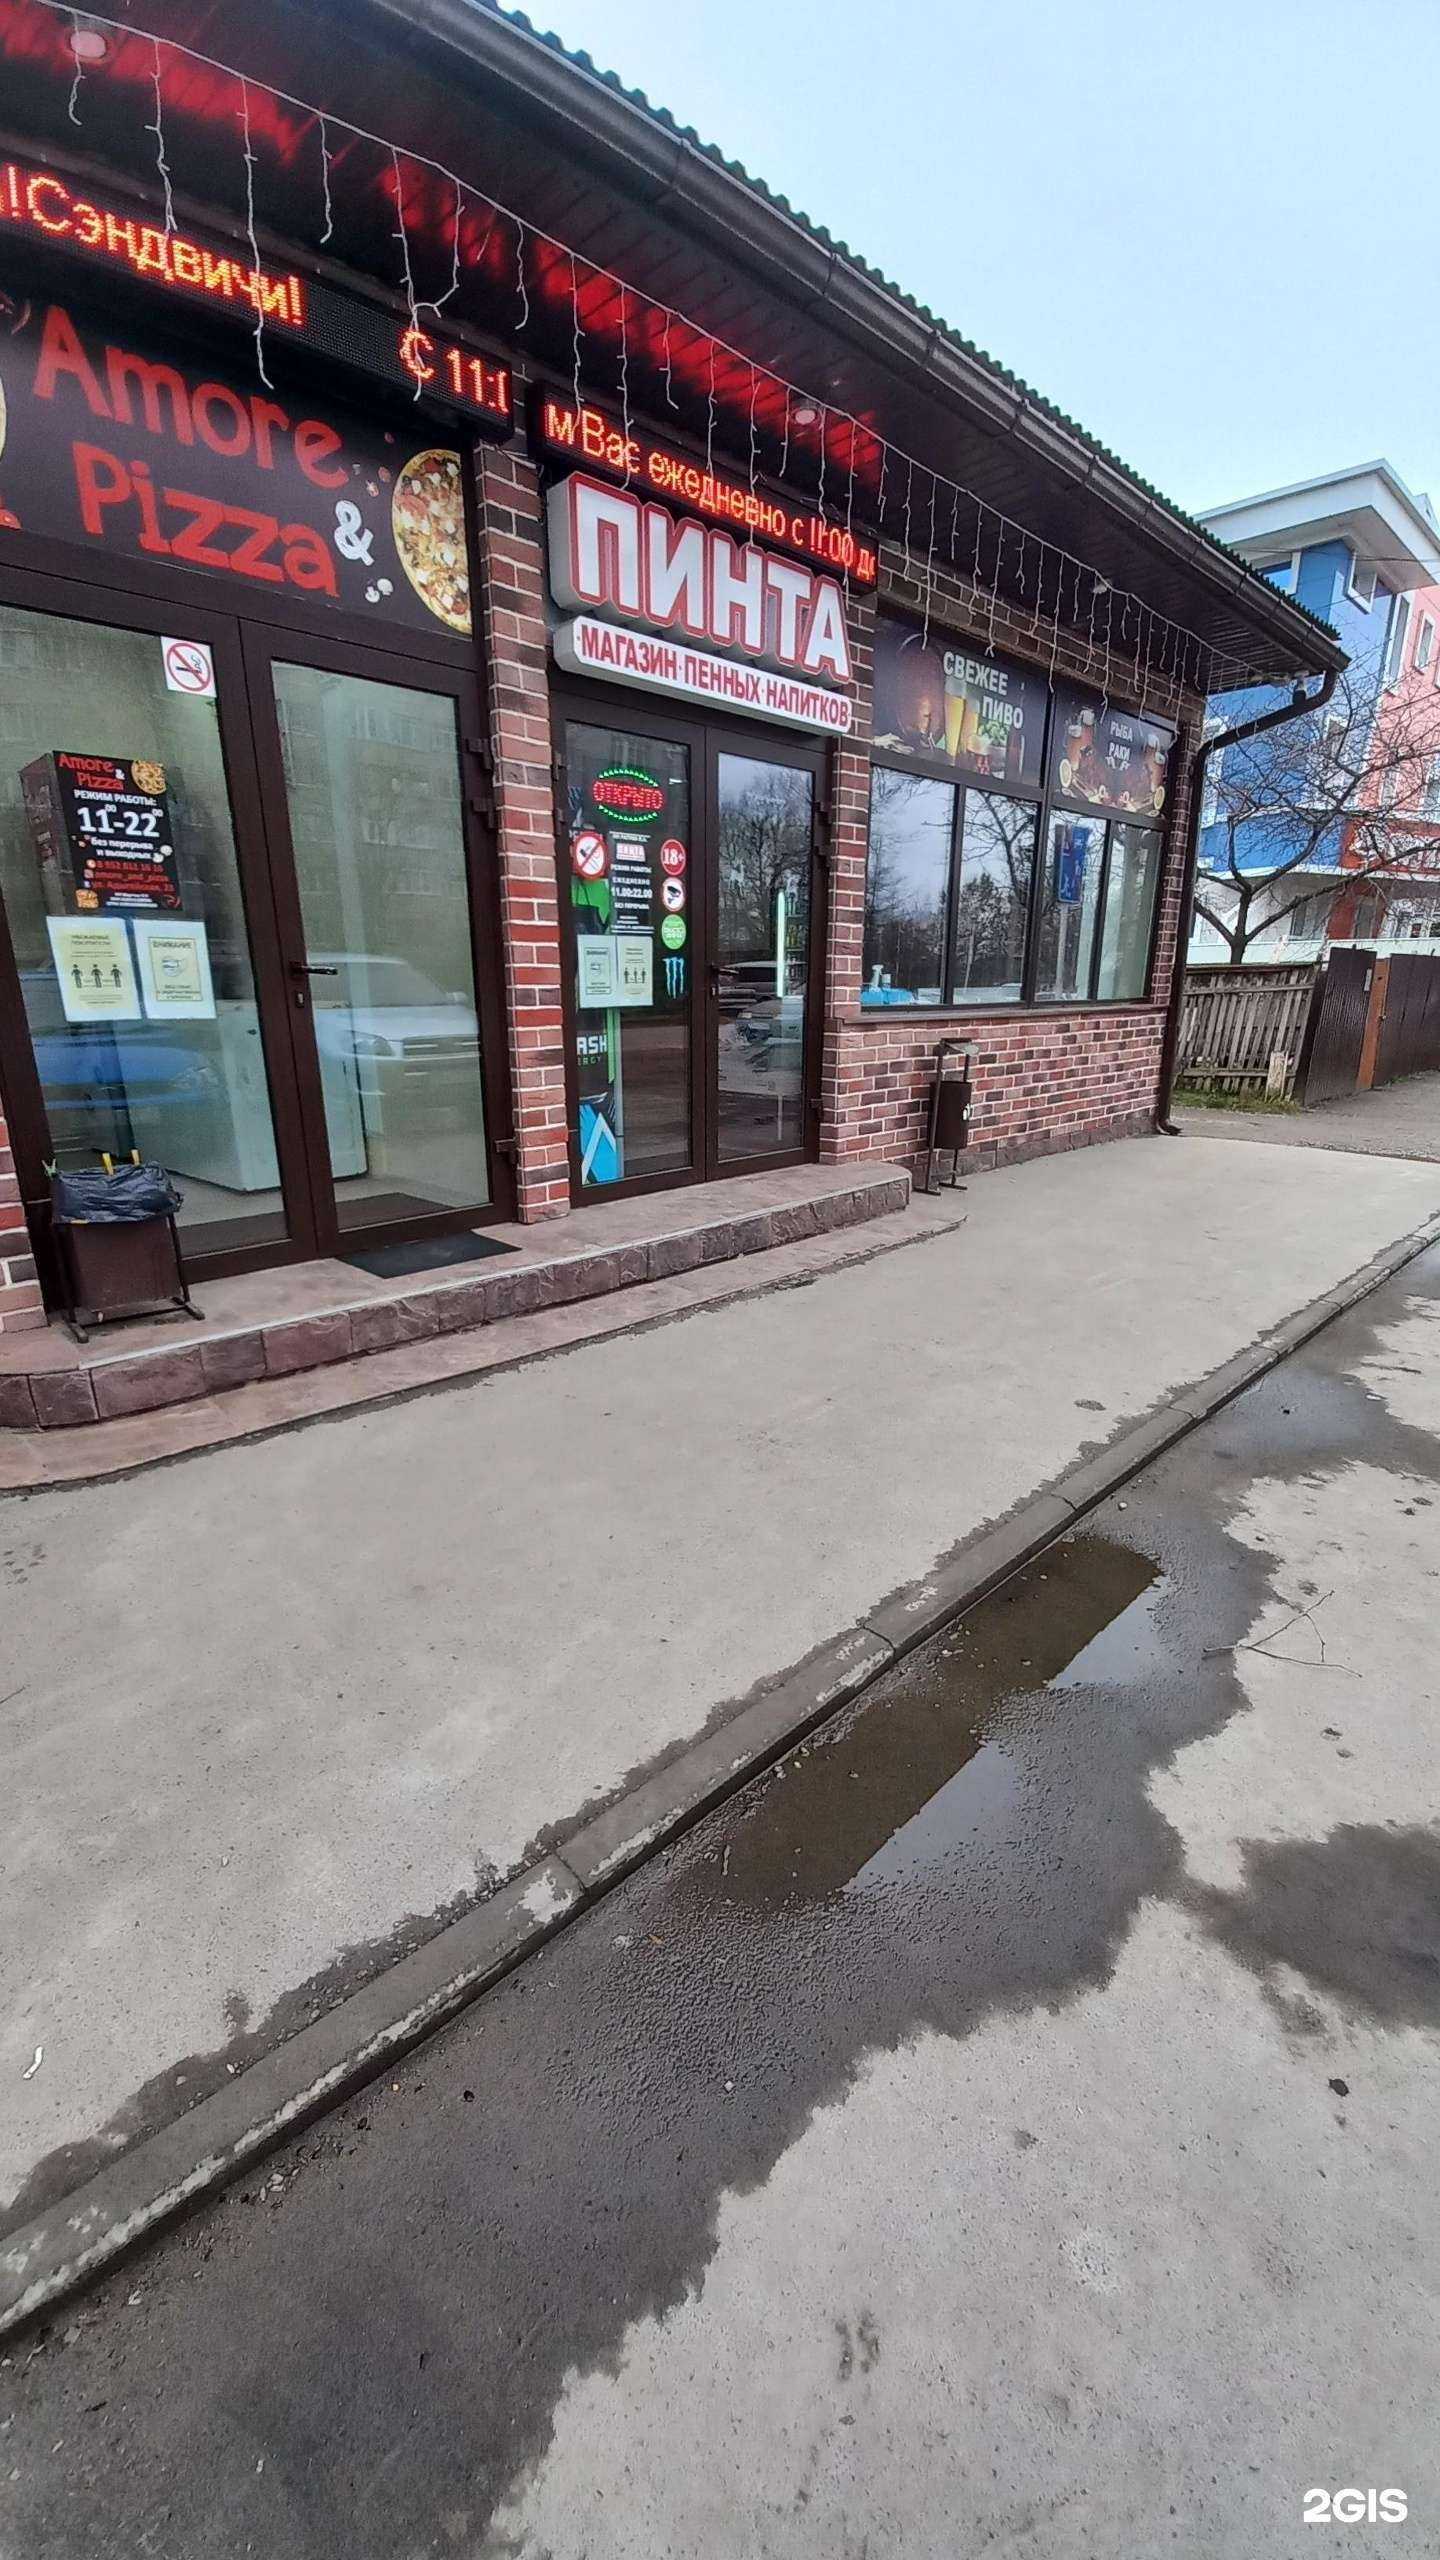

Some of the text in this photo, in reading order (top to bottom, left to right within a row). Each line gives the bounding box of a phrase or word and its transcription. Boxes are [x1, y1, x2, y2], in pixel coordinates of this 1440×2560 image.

[0, 165, 303, 325] !Сэндвичи!
[34, 305, 349, 489] Amore
[648, 451, 787, 538] ежедневно
[73, 441, 375, 599] Pizza &
[573, 478, 851, 681] ПИНТА
[580, 623, 850, 727] МАГАЗИН ПЕННЫХ НАПИТКОВ
[943, 651, 1009, 696] СВЕЖЕЕ
[982, 695, 1024, 729] ПИВО
[1110, 721, 1133, 742] РЫБА
[59, 753, 115, 773] Amore
[1108, 742, 1131, 761] РАКИ
[73, 789, 113, 802] РЕЖИМ
[77, 772, 124, 790] Pizza
[593, 781, 664, 810] ОТКРЫТО
[664, 847, 685, 866] 18+
